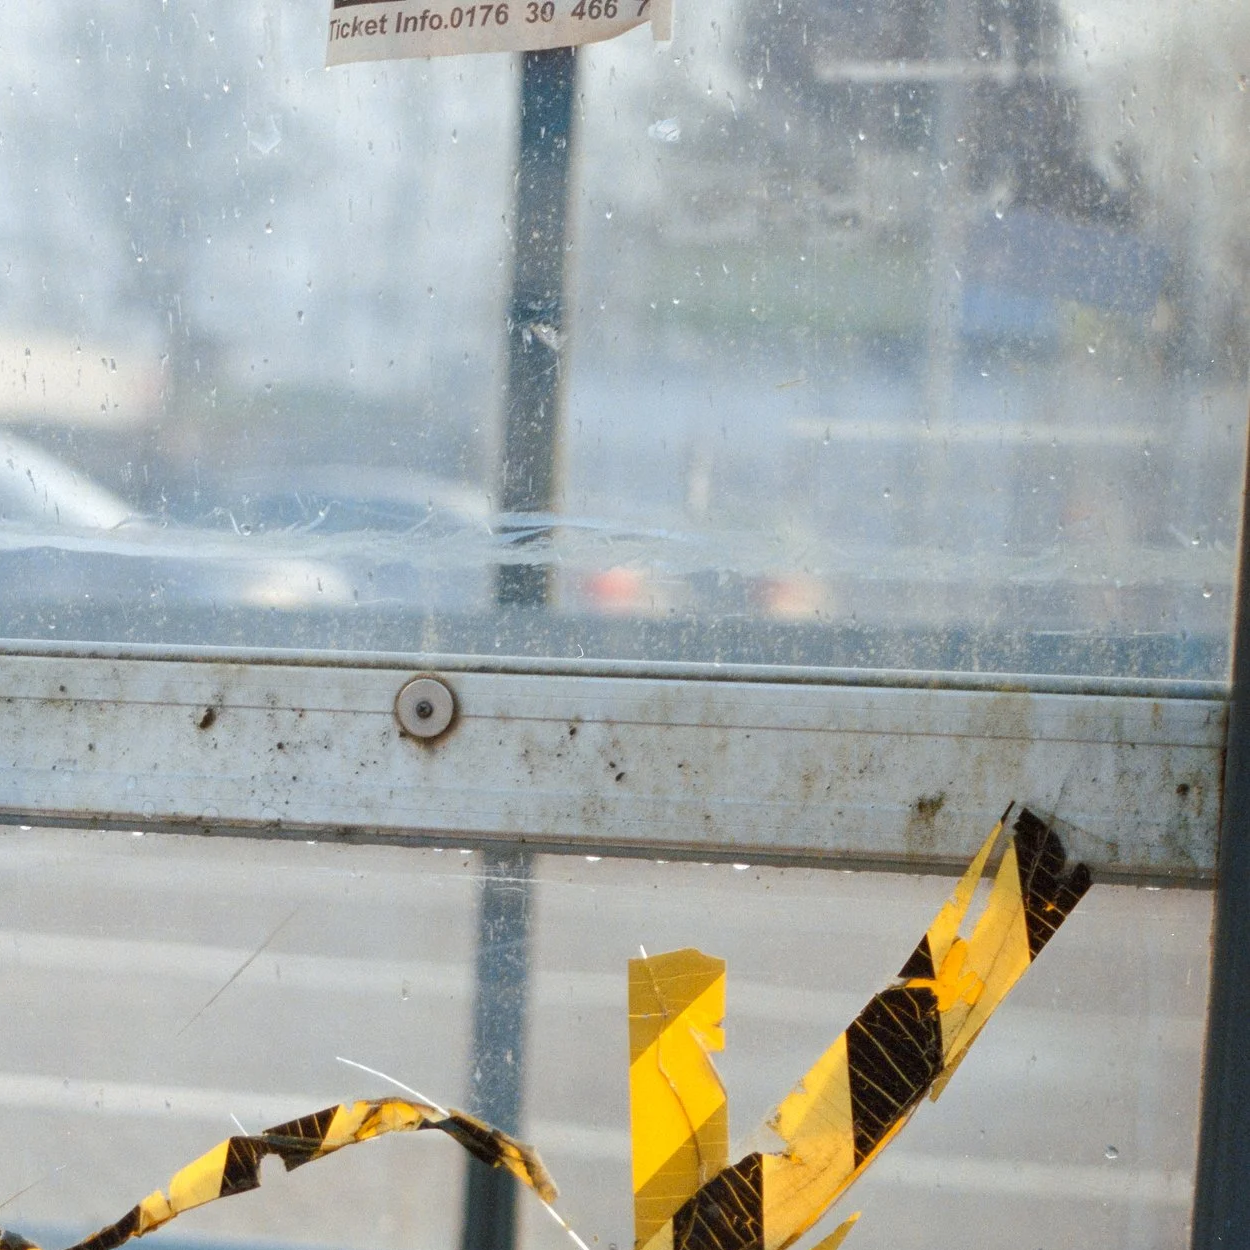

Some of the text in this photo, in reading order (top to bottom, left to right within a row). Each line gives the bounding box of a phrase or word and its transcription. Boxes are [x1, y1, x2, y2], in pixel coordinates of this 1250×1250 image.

[329, 12, 388, 41] Ticket
[525, 1, 555, 23] 30
[571, 0, 618, 20] 466
